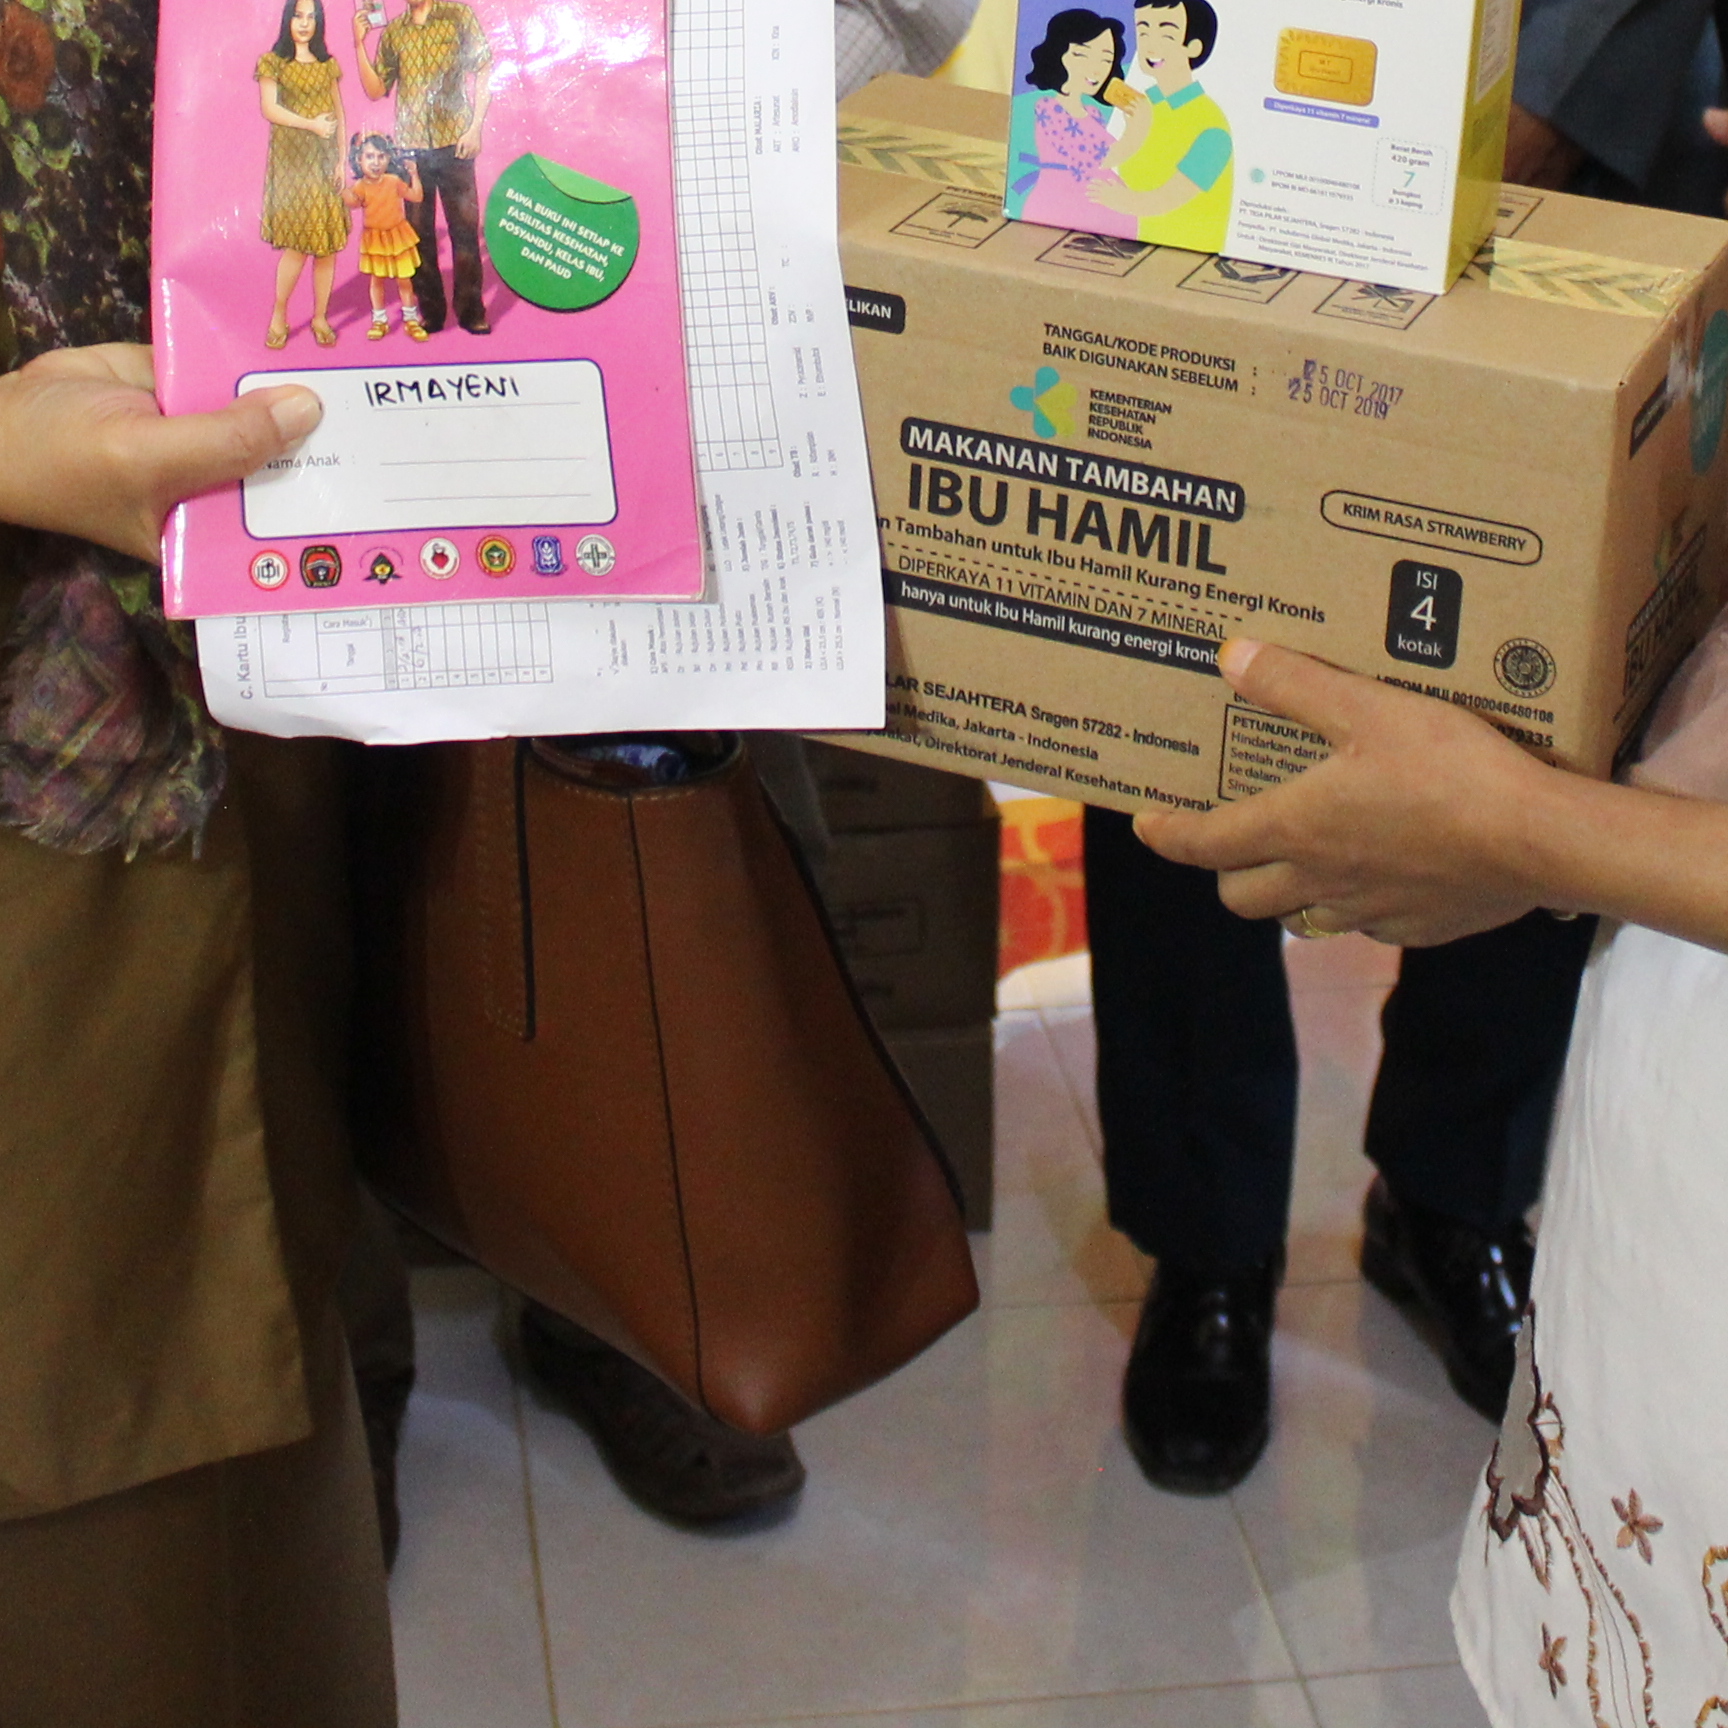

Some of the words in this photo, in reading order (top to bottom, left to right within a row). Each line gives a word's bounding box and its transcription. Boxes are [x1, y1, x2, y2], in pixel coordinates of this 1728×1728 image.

[506, 188, 533, 209] BAWA
[534, 203, 562, 223] BUKU
[562, 217, 577, 232] INI
[577, 225, 610, 248] SETIAP
[610, 242, 625, 257] KE
[507, 206, 552, 236] FASILITAS
[553, 229, 609, 267] KESEHATAN,
[499, 218, 554, 255] POSYANDU,
[555, 248, 585, 270] KELAS
[585, 264, 605, 282] IBU,
[521, 247, 544, 266] DAN
[544, 260, 572, 280] PAUD
[1044, 323, 1157, 357] TANGGAL/KODE
[1161, 346, 1235, 372] PRODUKSI
[1043, 343, 1076, 360] BAIK
[1080, 350, 1168, 379] DIGUNAKAN
[1172, 368, 1238, 393] SEBELUM
[365, 374, 520, 408] IRMAYENI
[1090, 388, 1172, 414] KEMENTERIAN
[1289, 377, 1313, 403] 25
[1320, 386, 1349, 410] OCT
[1335, 369, 1364, 393] OCT
[1370, 381, 1404, 406] 2017
[1088, 415, 1143, 434] REPUBLIK
[1089, 402, 1156, 425] KESEHATAN
[1087, 427, 1152, 450] INDONESIA
[908, 425, 1057, 478] MAKANAN
[1066, 458, 1237, 514] TAMBAHAN
[909, 463, 1008, 527] IBU
[1027, 486, 1227, 575] HAMIL
[1343, 502, 1380, 522] KRIM
[1384, 511, 1423, 532] RASA
[1426, 520, 1527, 551] STRAWBERRY
[895, 515, 985, 550] Tambahan
[992, 540, 1042, 563] untuk
[1047, 549, 1075, 570] Ibu
[1080, 557, 1131, 582] Hamil
[1136, 568, 1201, 600] Kurang
[1206, 583, 1263, 612] Energi
[1268, 597, 1325, 623] Kronis
[1416, 570, 1438, 591] ISI
[898, 555, 990, 589] DIPERKAYA
[996, 577, 1012, 593] 11
[1018, 581, 1090, 611] VITAMIN
[1094, 598, 1132, 620] DAN
[1137, 608, 1147, 622] 7
[1151, 610, 1227, 641] MINERAL
[1410, 595, 1437, 631] 4
[234, 616, 248, 639] Ibu
[901, 581, 945, 606] hanya
[949, 593, 992, 616] untuk
[994, 602, 1019, 621] Ibu
[1022, 609, 1066, 633] Hamil
[1069, 617, 1120, 647] kurang
[1124, 632, 1172, 657] energi
[236, 643, 251, 682] Kartu
[1397, 634, 1442, 659] kotak
[904, 705, 960, 730] Medika,
[962, 717, 1016, 742] Jakarta
[1027, 732, 1099, 761] Indonesia
[923, 682, 1027, 717] SEJAHTERA
[1031, 707, 1079, 730] Sragen
[1082, 718, 1122, 739] 57282
[1133, 728, 1200, 757] Indonesia
[1230, 747, 1273, 767] Setelah
[1231, 731, 1291, 755] Hindarkan
[1294, 744, 1317, 760] dari
[925, 734, 997, 764] Direktorat
[999, 752, 1062, 779] Jenderal
[1065, 767, 1140, 797] Kesehatan
[1228, 763, 1243, 776] ke
[1244, 766, 1281, 784] dalam
